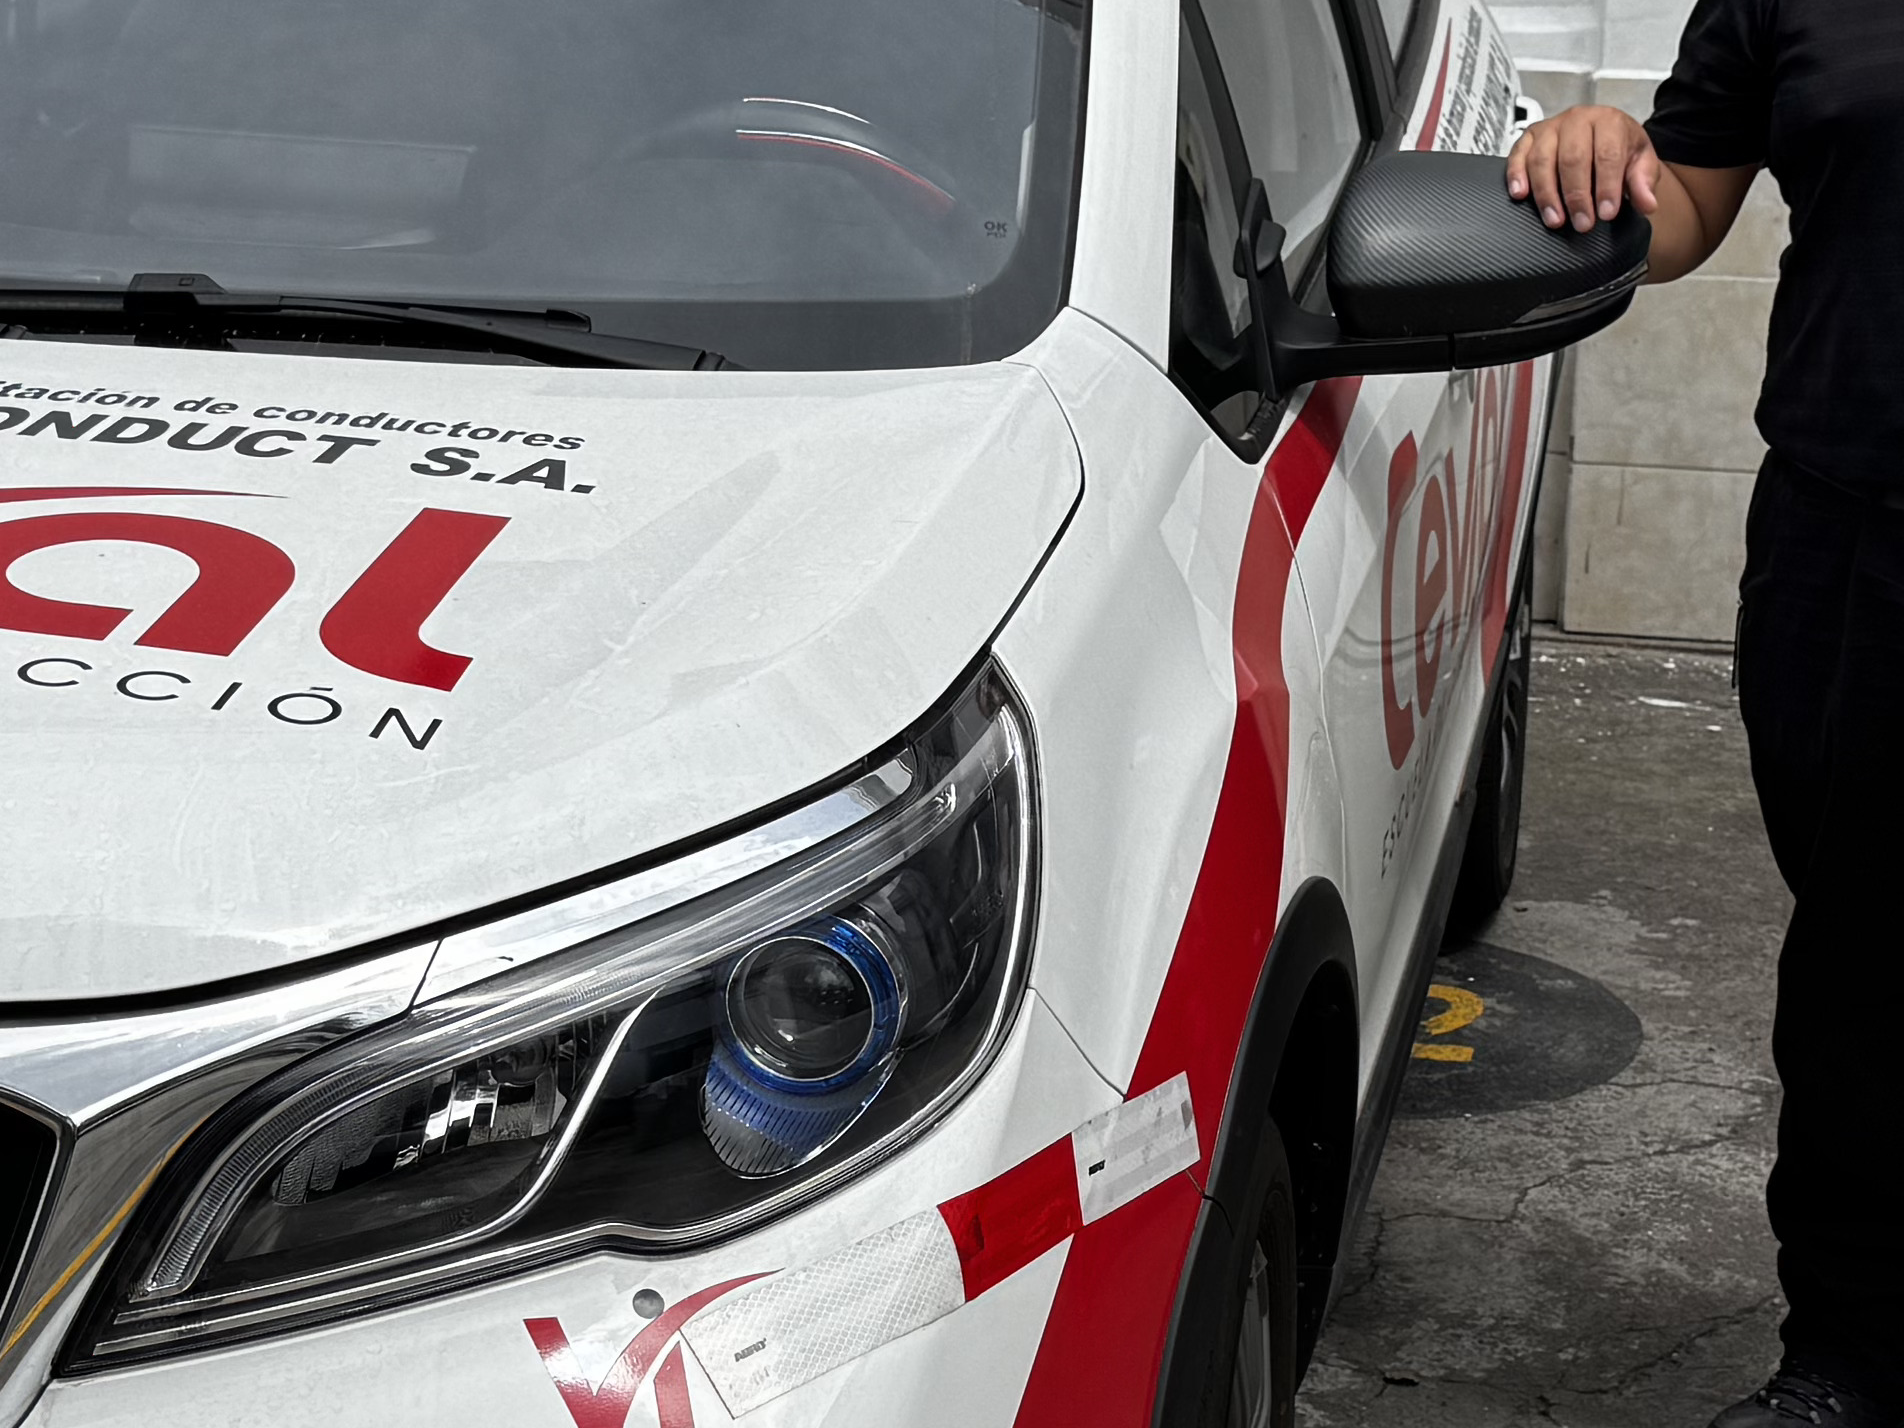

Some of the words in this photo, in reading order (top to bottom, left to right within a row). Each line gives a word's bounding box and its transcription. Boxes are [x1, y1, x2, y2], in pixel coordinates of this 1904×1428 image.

[173, 396, 240, 418] de
[251, 404, 586, 452] conductores
[409, 446, 598, 495] S.A.
